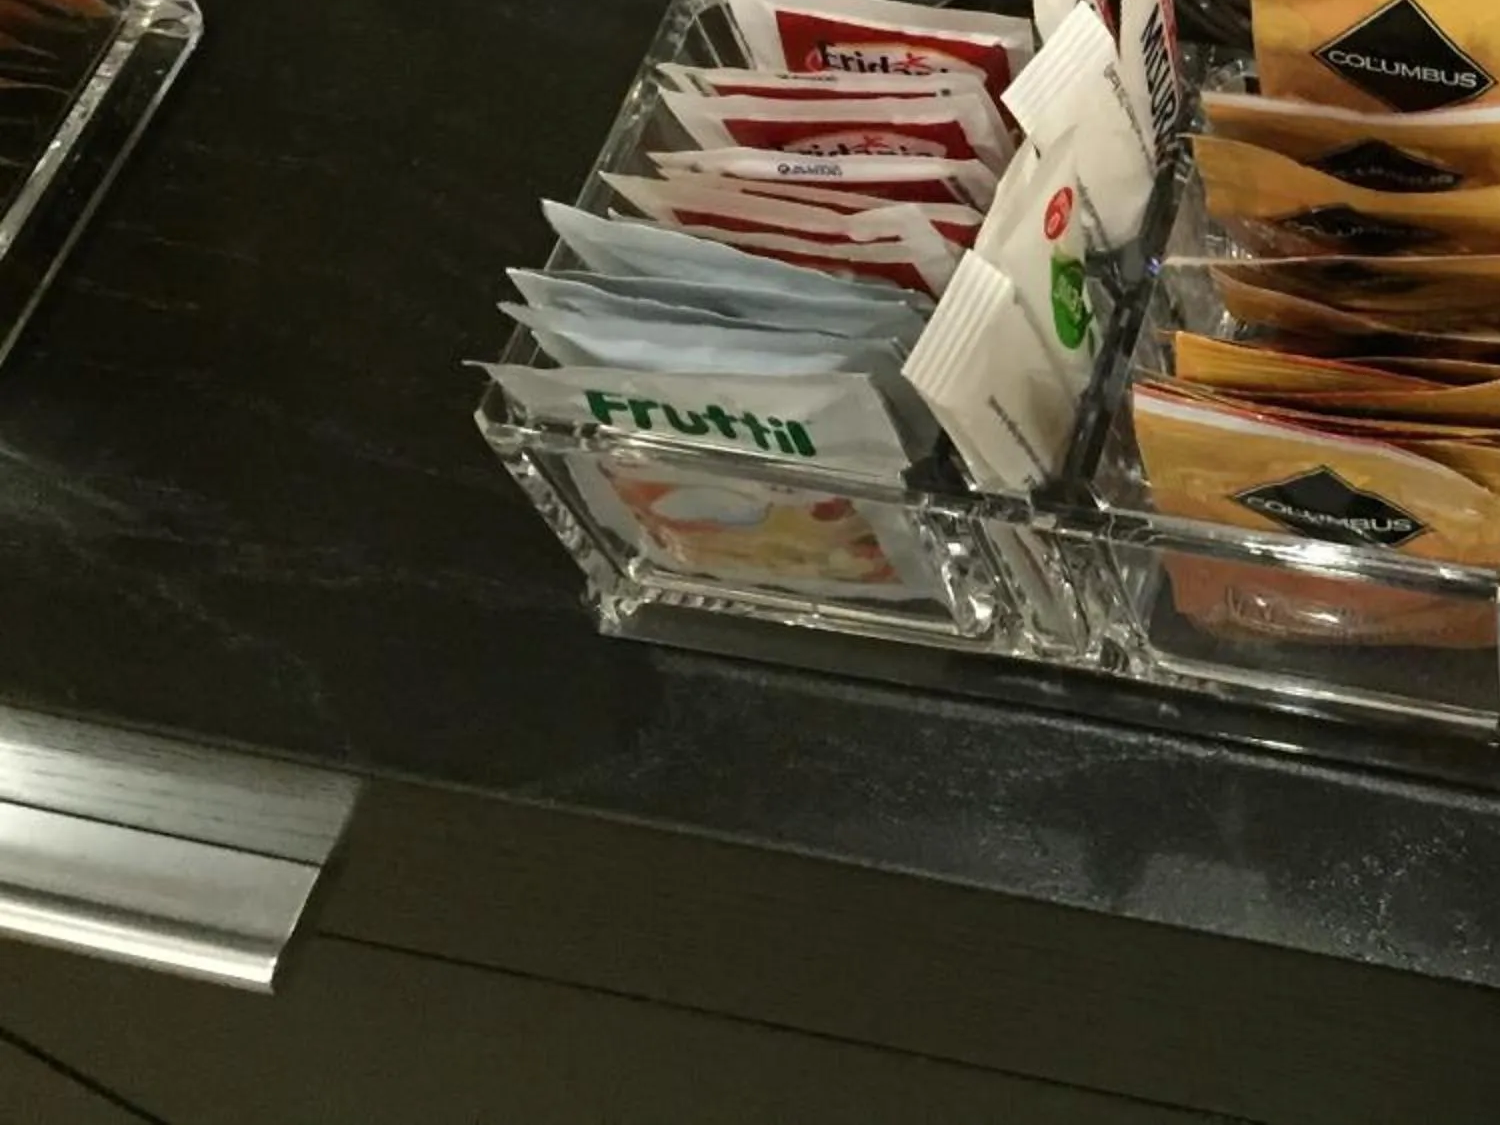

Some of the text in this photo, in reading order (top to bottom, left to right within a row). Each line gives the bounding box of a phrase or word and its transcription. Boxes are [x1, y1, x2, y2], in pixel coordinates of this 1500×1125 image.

[1326, 49, 1478, 89] COLUMBUS
[585, 389, 817, 458] Fruttil
[1245, 493, 1414, 535] COLUMBUS
